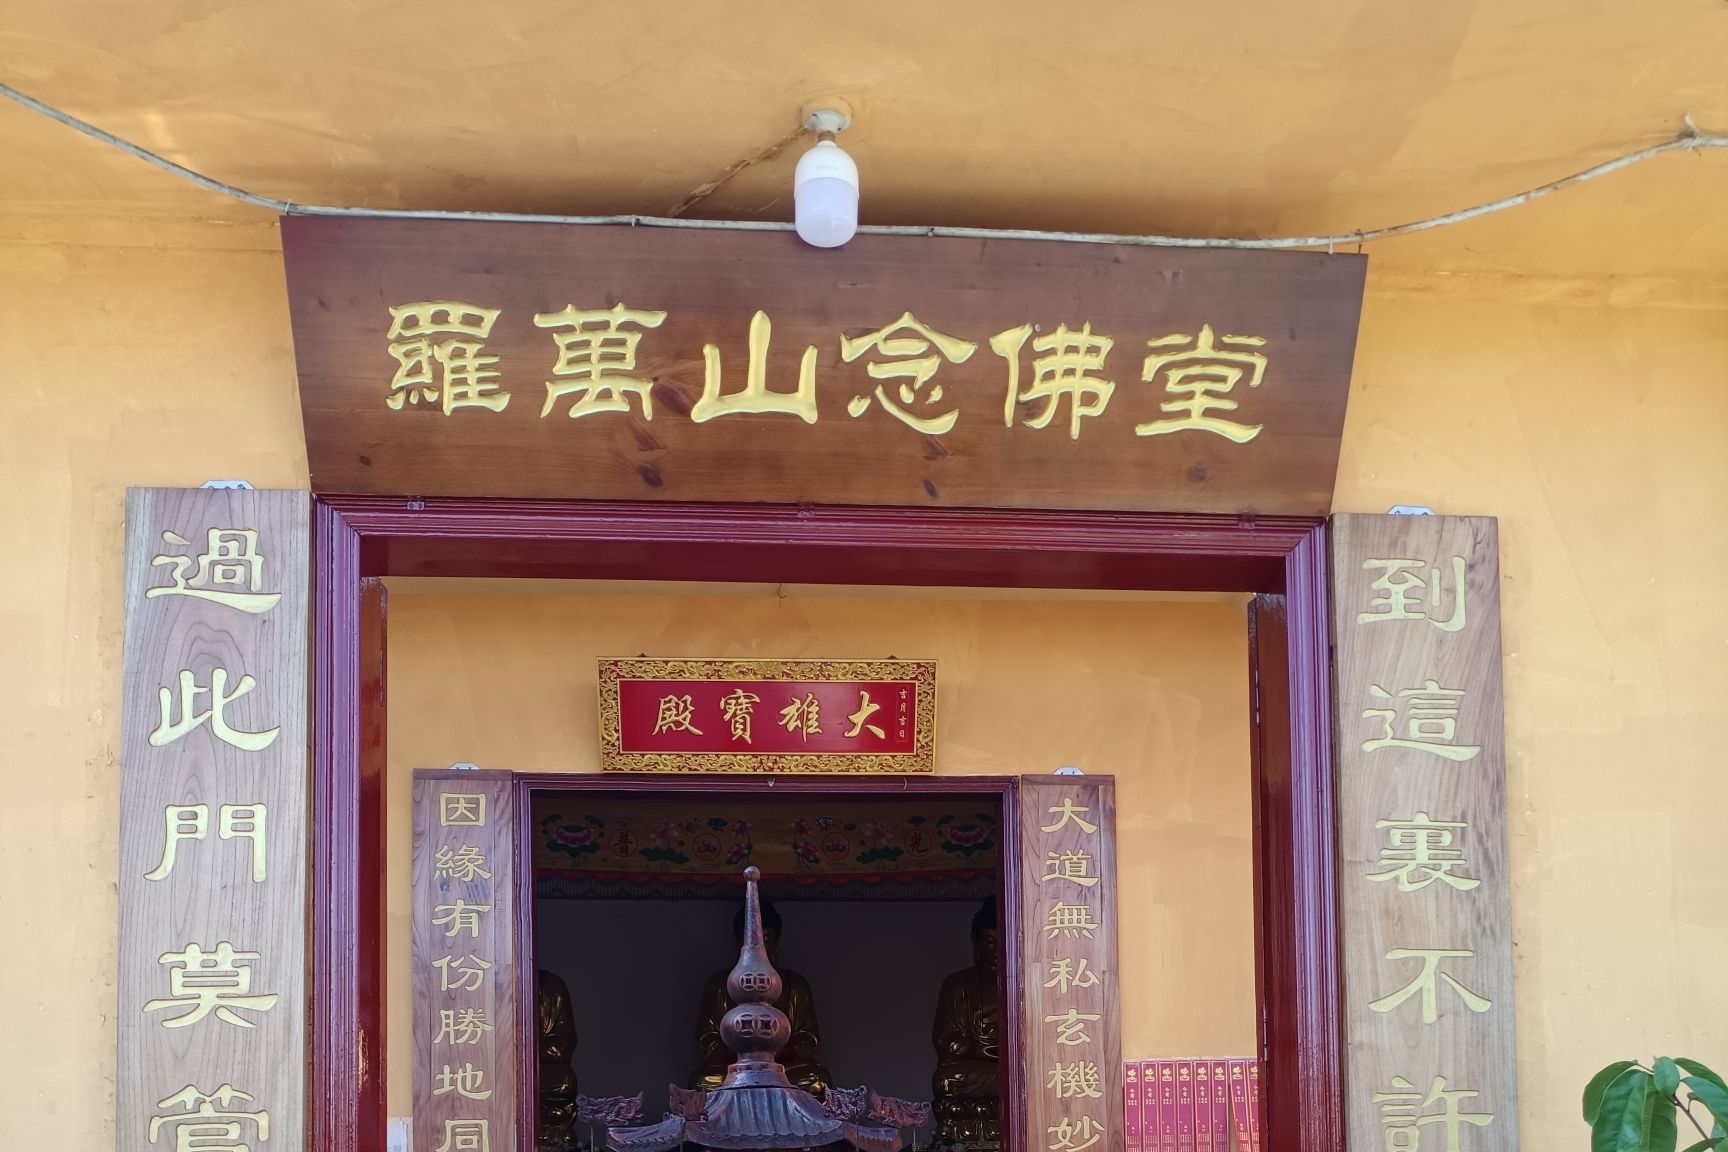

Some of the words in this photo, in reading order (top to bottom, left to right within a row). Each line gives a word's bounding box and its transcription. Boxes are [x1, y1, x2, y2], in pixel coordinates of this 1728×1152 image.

[385, 299, 1269, 446] 羅萬山念佛堂
[651, 688, 886, 745] 大雄寶殿
[898, 688, 908, 738] 吉月吉日
